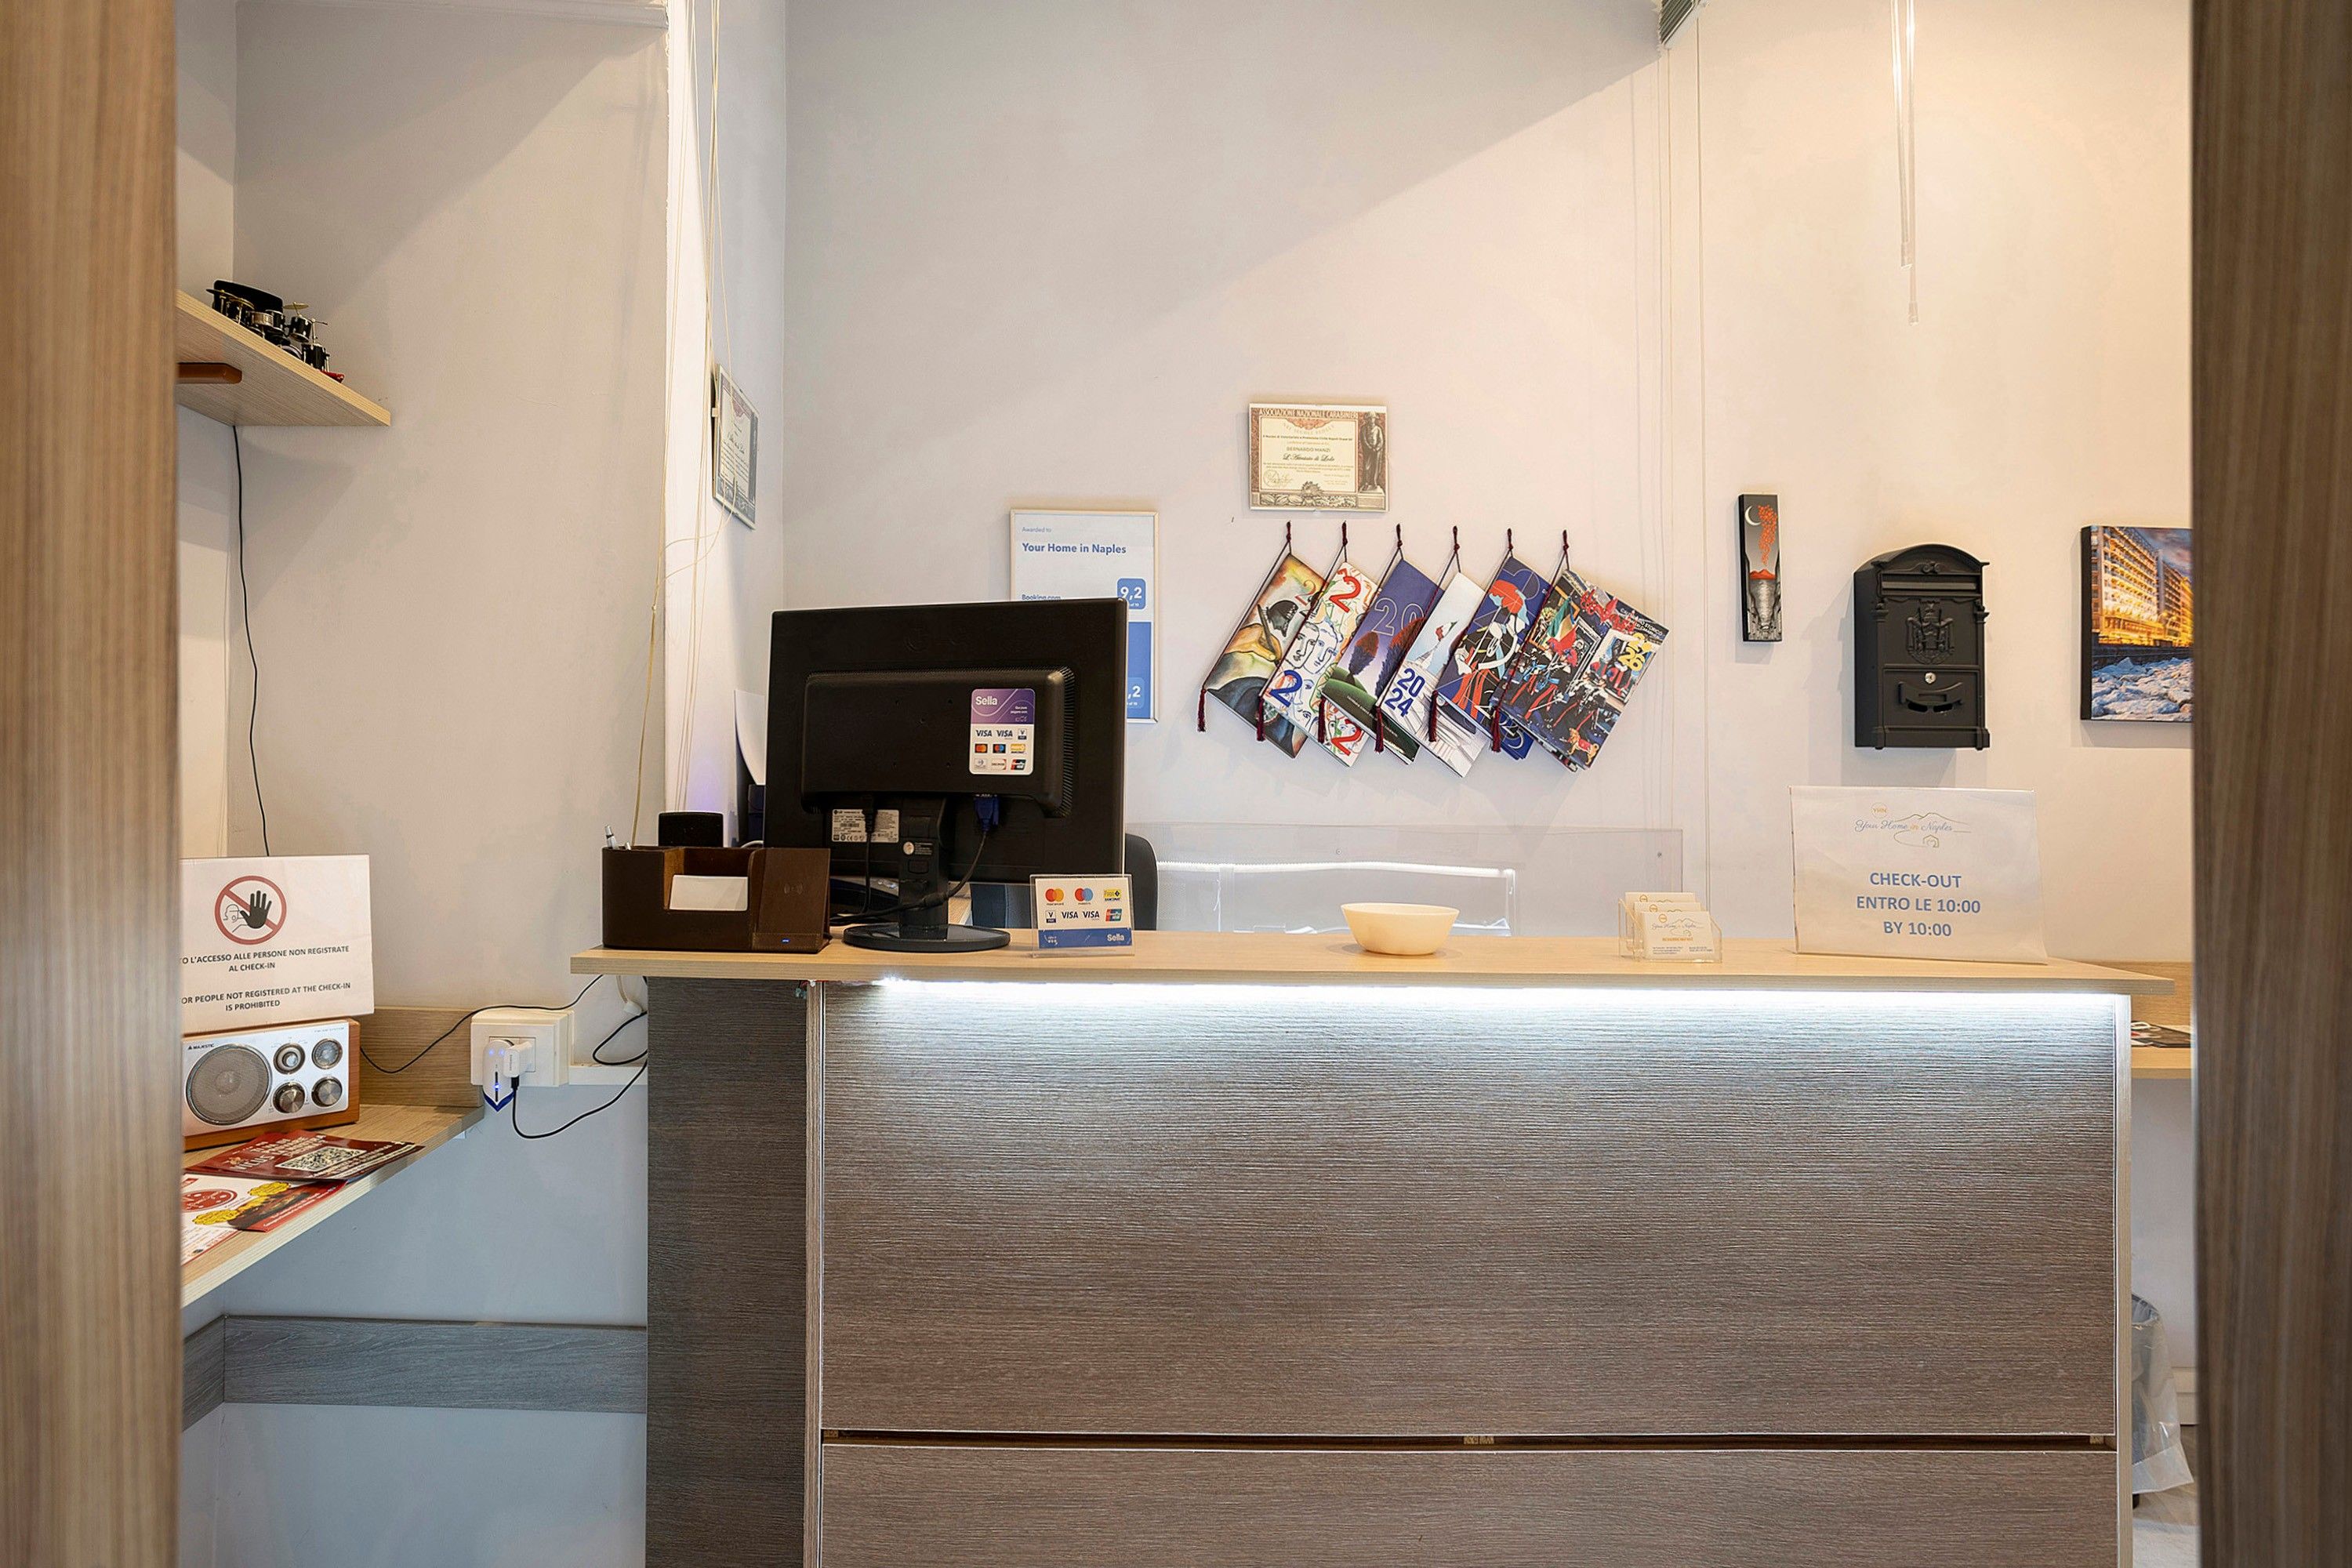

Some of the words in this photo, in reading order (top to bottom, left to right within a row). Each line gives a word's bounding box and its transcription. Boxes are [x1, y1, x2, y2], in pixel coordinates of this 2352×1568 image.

[1022, 543, 1045, 552] Your
[1047, 543, 1077, 553] Home
[1080, 543, 1089, 553] in
[1092, 544, 1127, 556] Naples
[1120, 586, 1142, 601] 9,2
[1617, 646, 1646, 672] 26
[1396, 668, 1426, 698] 20
[975, 695, 998, 706] Sella
[1384, 688, 1414, 717] 24
[1855, 819, 1879, 832] Your
[1881, 820, 1908, 829] Home
[1921, 822, 1953, 833] Naples
[1870, 872, 1962, 888] CHECK-OUT
[1857, 896, 1911, 910] ENTRO
[1915, 898, 1932, 911] LE
[1937, 899, 1981, 913] 10:00
[1883, 921, 1903, 934] BY
[1908, 922, 1952, 937] 10:00
[1107, 933, 1125, 942] Sella
[191, 953, 232, 964] L'ACCESSO
[253, 950, 288, 959] PERSONE
[307, 946, 350, 955] REGISTRATE
[240, 962, 275, 971] CHECK-IN
[194, 993, 224, 1003] PEOPLE
[245, 988, 290, 998] REGISTERED
[318, 982, 350, 992] CHECK-IN
[234, 1000, 281, 1011] PROHIBITED
